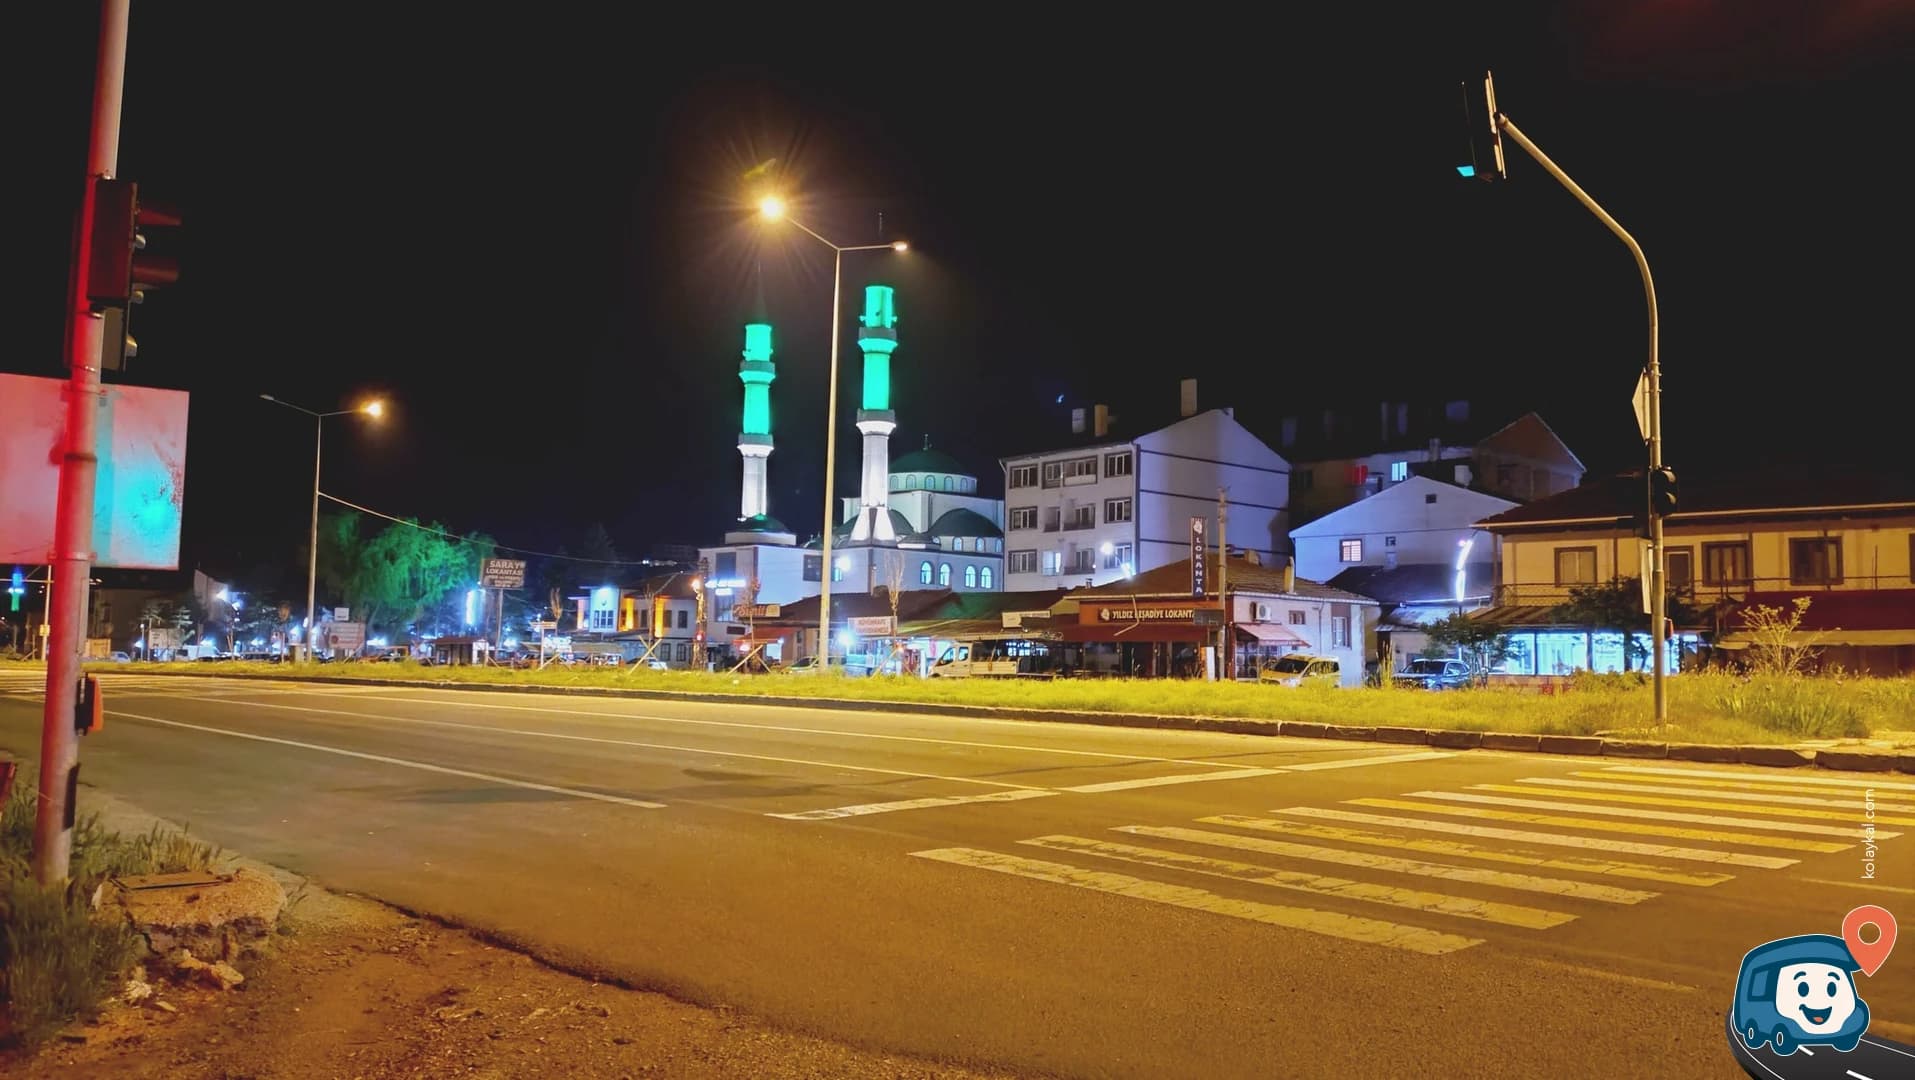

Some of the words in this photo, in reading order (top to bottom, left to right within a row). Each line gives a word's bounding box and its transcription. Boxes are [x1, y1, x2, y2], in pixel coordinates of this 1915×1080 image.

[1195, 537, 1203, 593] LOKANTA
[1112, 610, 1133, 619] YILDIZ
[1165, 609, 1195, 619] LOKANT
